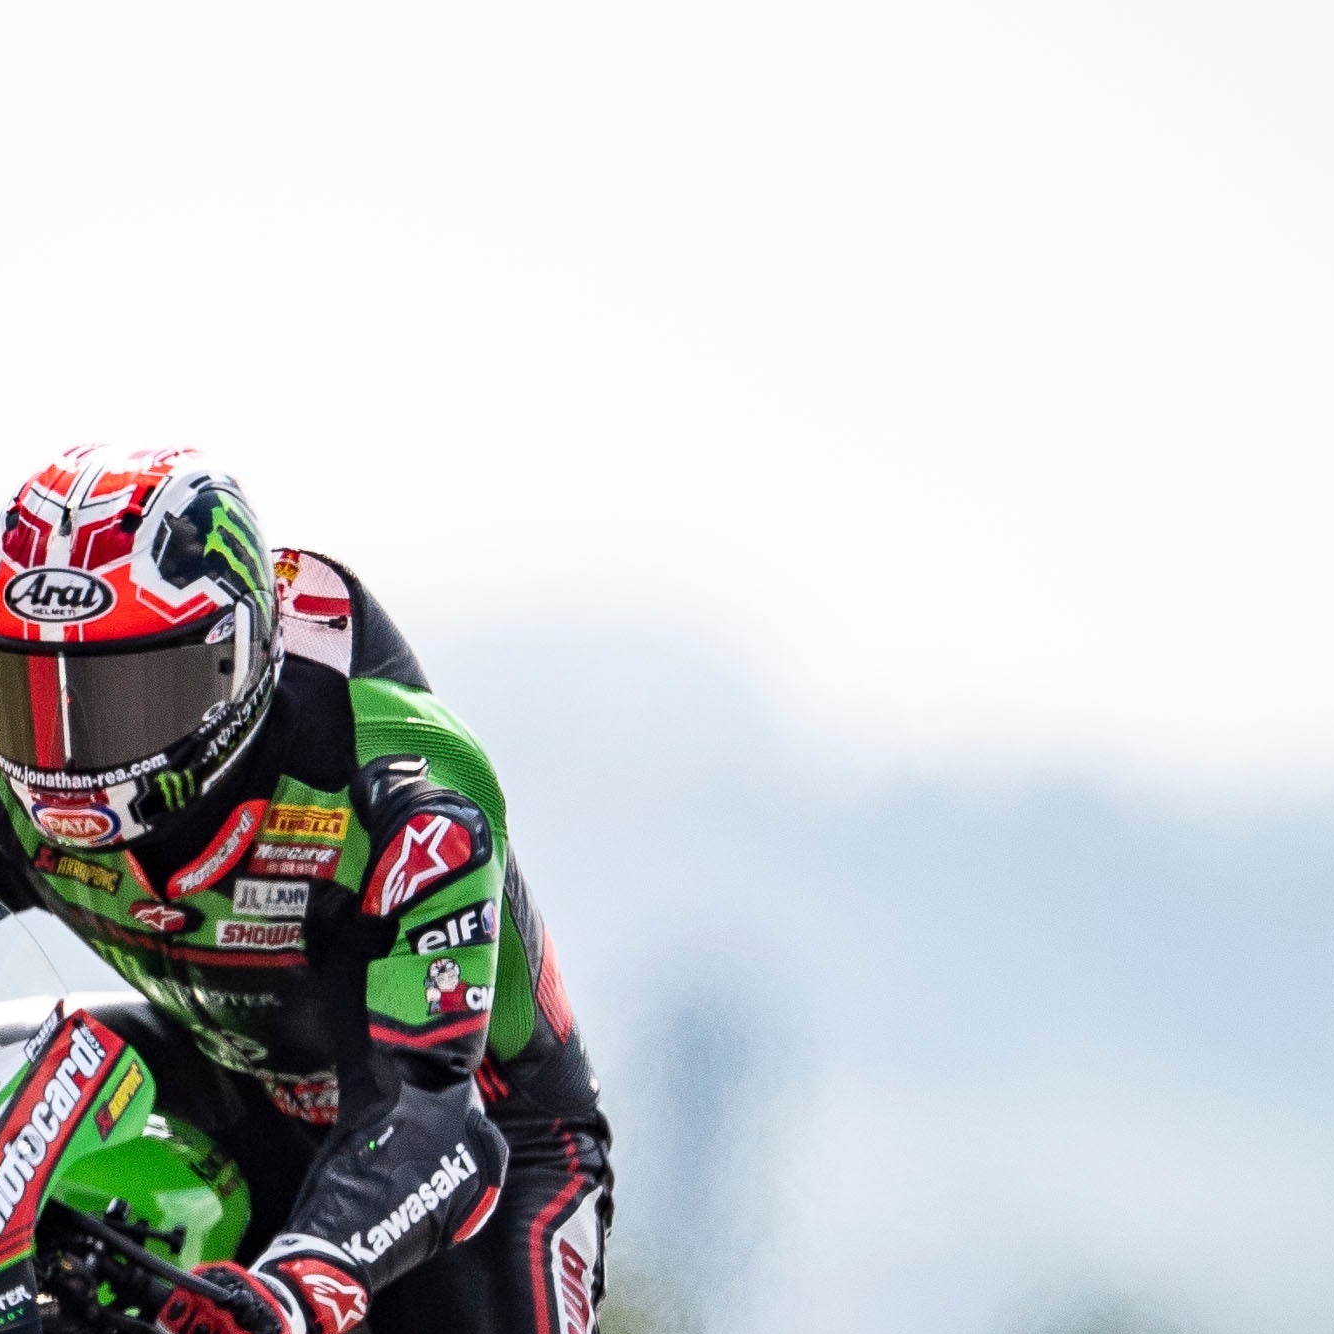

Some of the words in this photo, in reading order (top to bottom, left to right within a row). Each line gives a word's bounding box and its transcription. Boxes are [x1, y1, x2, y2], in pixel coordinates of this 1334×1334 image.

[8, 573, 99, 608] Arai
[47, 816, 101, 834] PATA
[267, 807, 346, 834] PIRELLI
[221, 922, 303, 945] SHOWA
[417, 910, 479, 957] elf
[341, 1142, 478, 1264] Kawasaki
